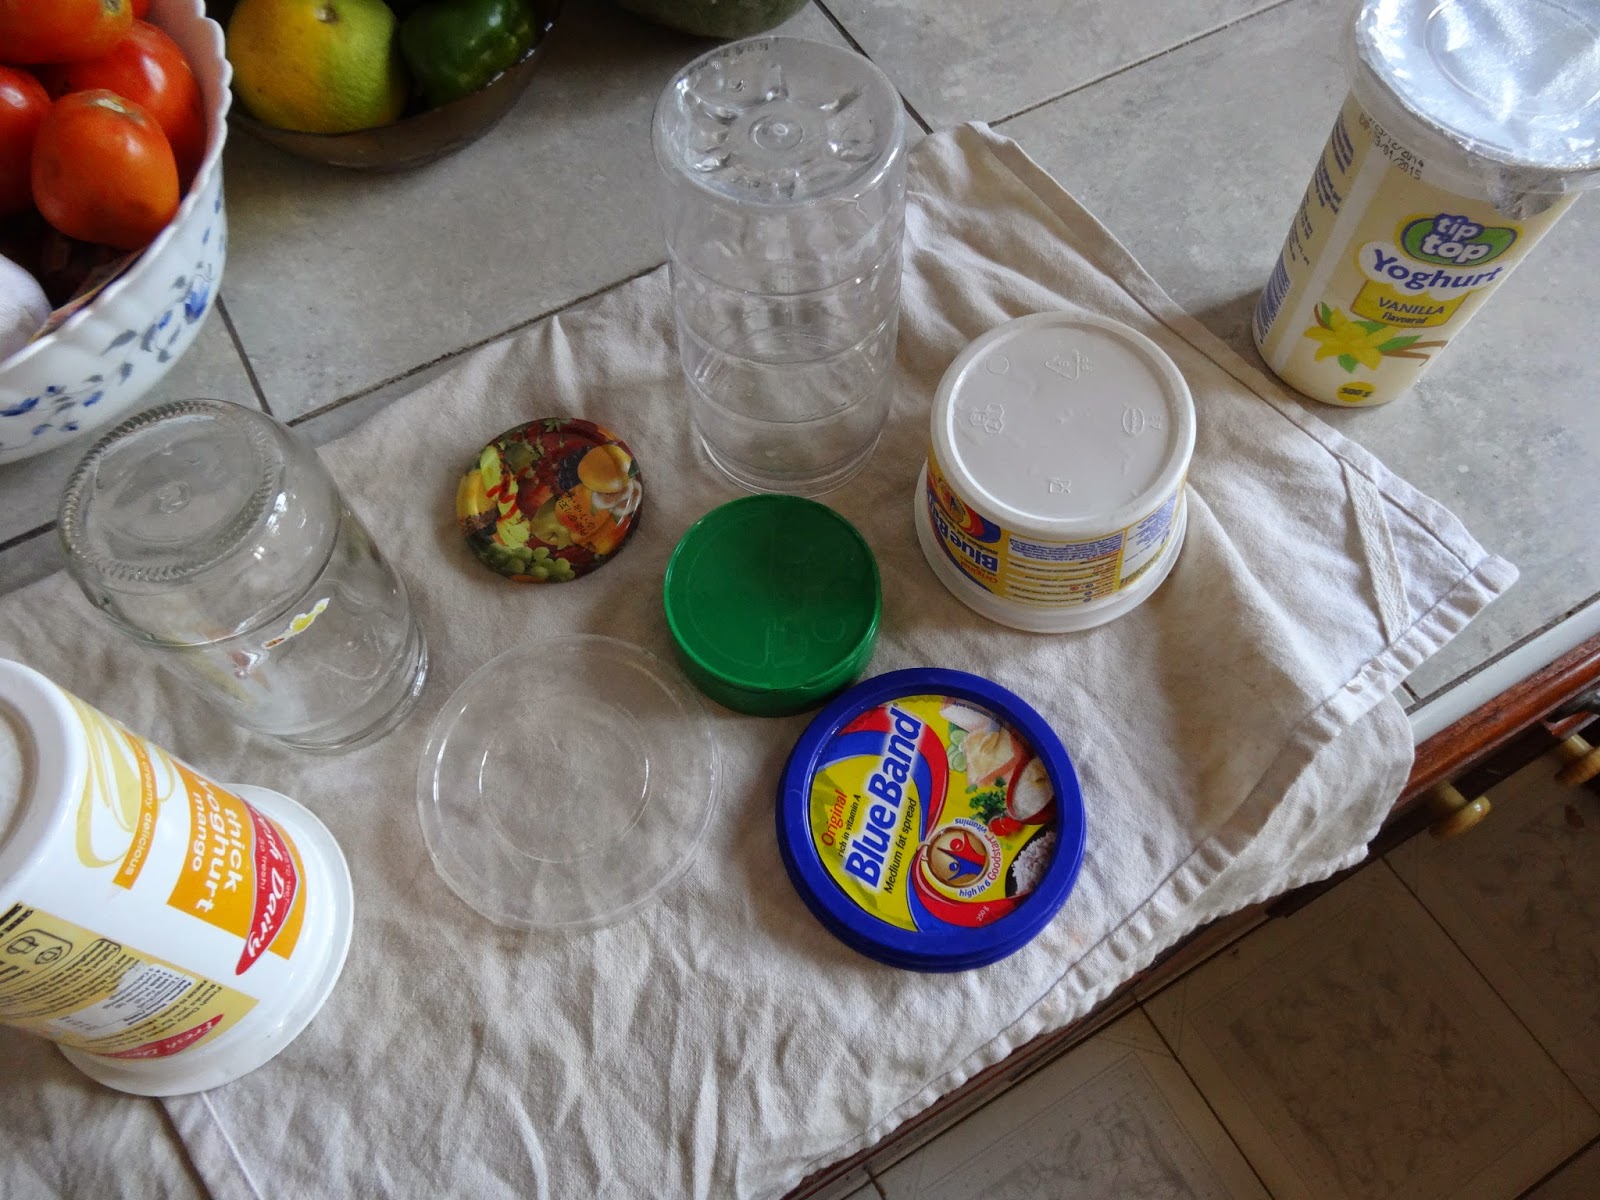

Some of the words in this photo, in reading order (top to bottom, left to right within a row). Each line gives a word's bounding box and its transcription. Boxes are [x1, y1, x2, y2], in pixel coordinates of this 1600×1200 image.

[1422, 234, 1490, 263] top
[1438, 217, 1478, 242] tip
[1373, 248, 1504, 290] Yoghurt
[1379, 296, 1445, 315] VANILLA
[950, 529, 998, 572] Blue
[868, 706, 923, 808] Band
[142, 761, 154, 810] creamy
[192, 791, 207, 872] mango
[821, 789, 848, 847] Original
[837, 843, 848, 858] rich
[844, 831, 850, 844] in
[848, 801, 859, 832] vitamin
[854, 794, 862, 802] A
[954, 818, 988, 834] vitamins
[125, 812, 152, 876] delicious
[194, 776, 230, 913] yoghurt
[224, 807, 245, 893] thick
[845, 804, 897, 888] Blue
[884, 852, 902, 894] Medium
[896, 834, 906, 853] fat
[902, 797, 918, 834] spread
[259, 854, 268, 891] fresh!
[958, 889, 977, 898] high
[977, 883, 986, 892] in
[984, 879, 991, 888] 6
[247, 866, 285, 958] Dairy
[976, 909, 987, 922] 250
